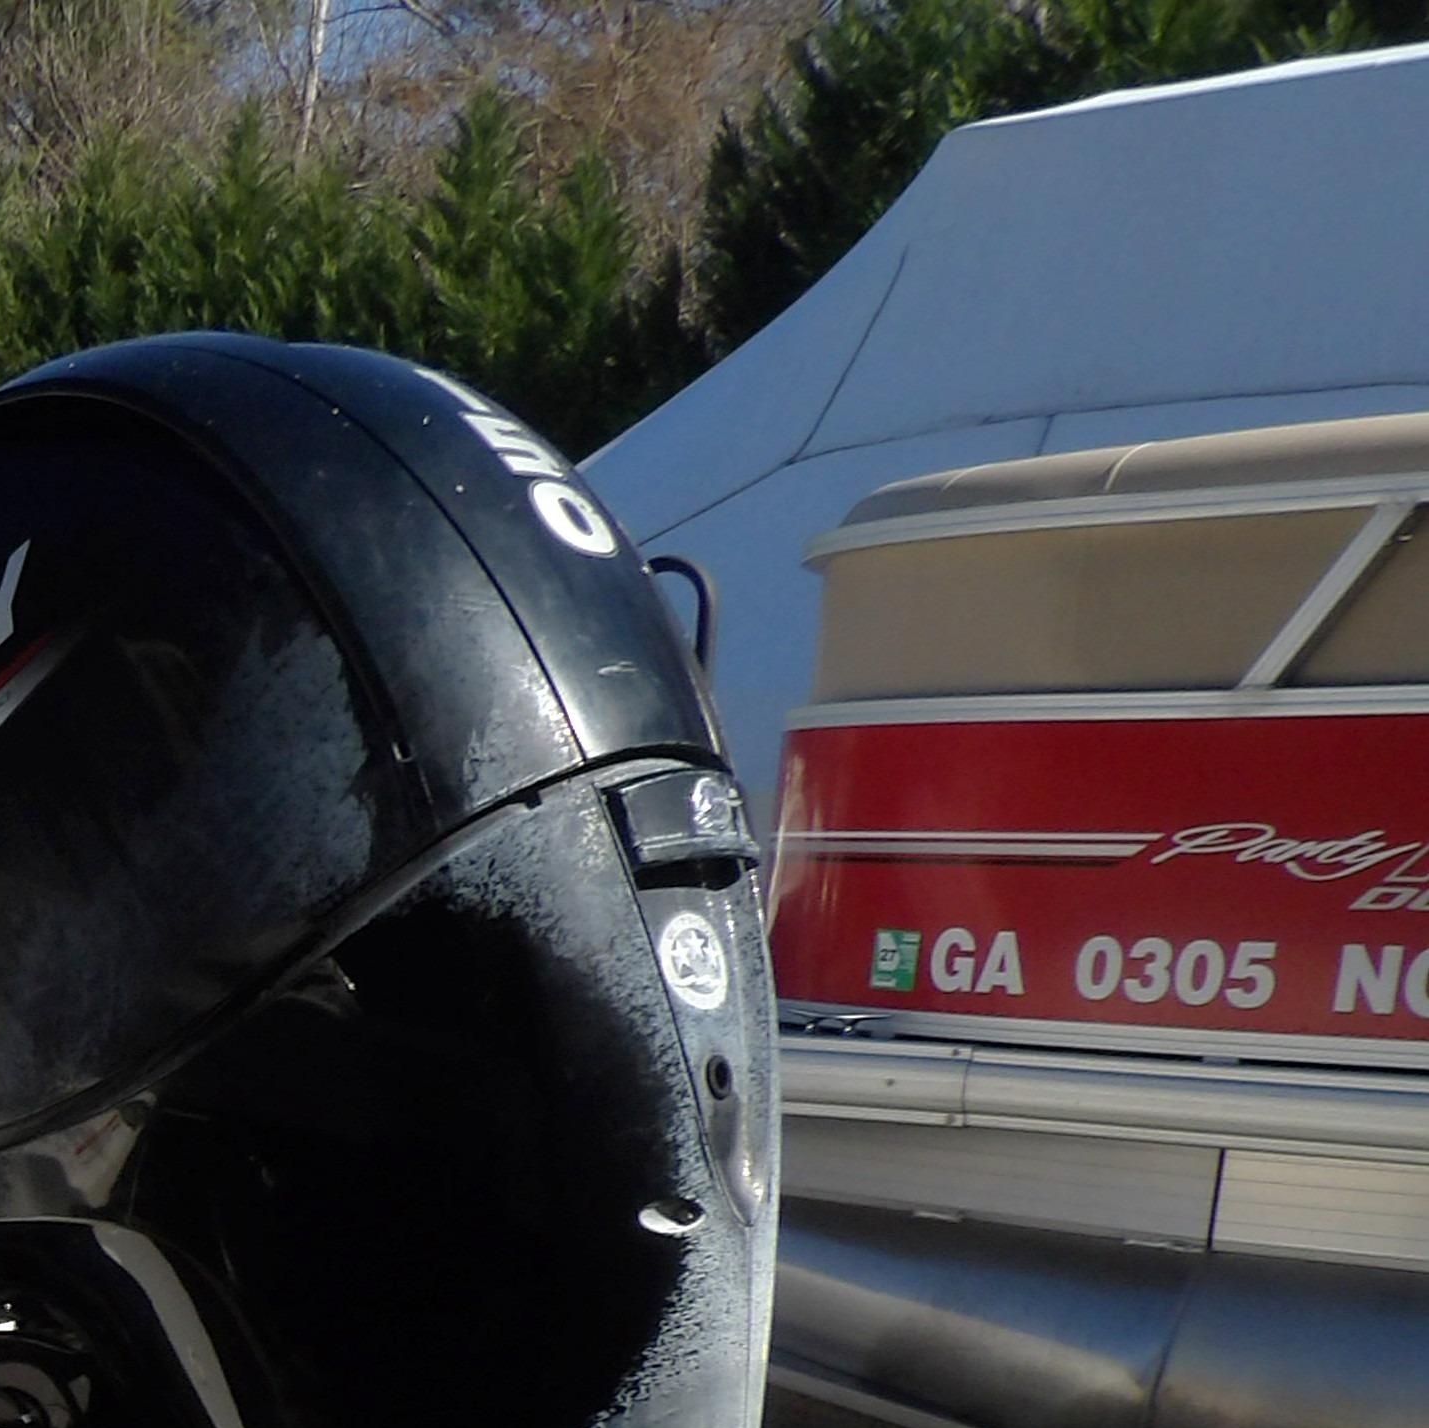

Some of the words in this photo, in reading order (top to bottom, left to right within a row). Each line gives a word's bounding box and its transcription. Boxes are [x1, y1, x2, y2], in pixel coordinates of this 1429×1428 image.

[1149, 822, 1422, 881] Party
[930, 926, 1026, 996] GA
[1074, 934, 1278, 1009] 0305
